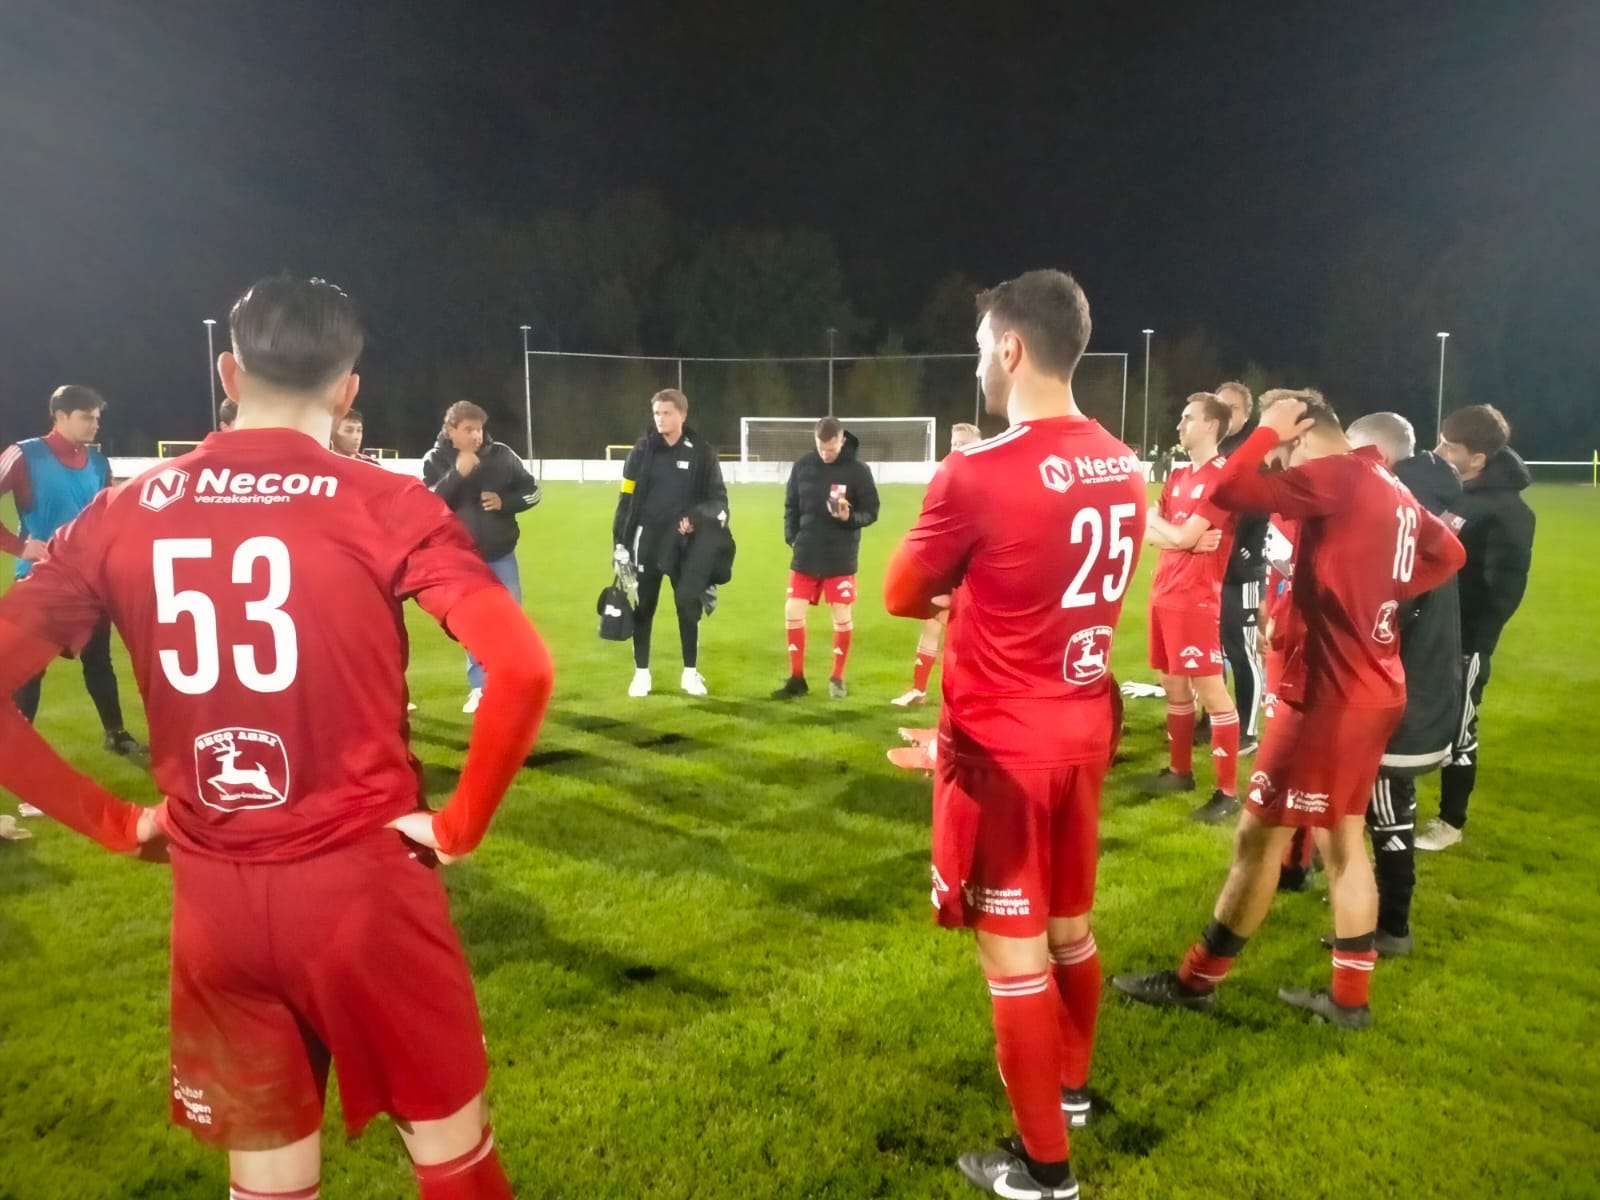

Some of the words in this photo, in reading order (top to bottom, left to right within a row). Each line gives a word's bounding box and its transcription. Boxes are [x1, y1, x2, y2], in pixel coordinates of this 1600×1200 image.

[194, 495, 290, 505] verzekeringen
[196, 468, 338, 497] Necon
[1061, 502, 1136, 608] 25
[1392, 504, 1417, 583] 16
[153, 535, 298, 695] 53
